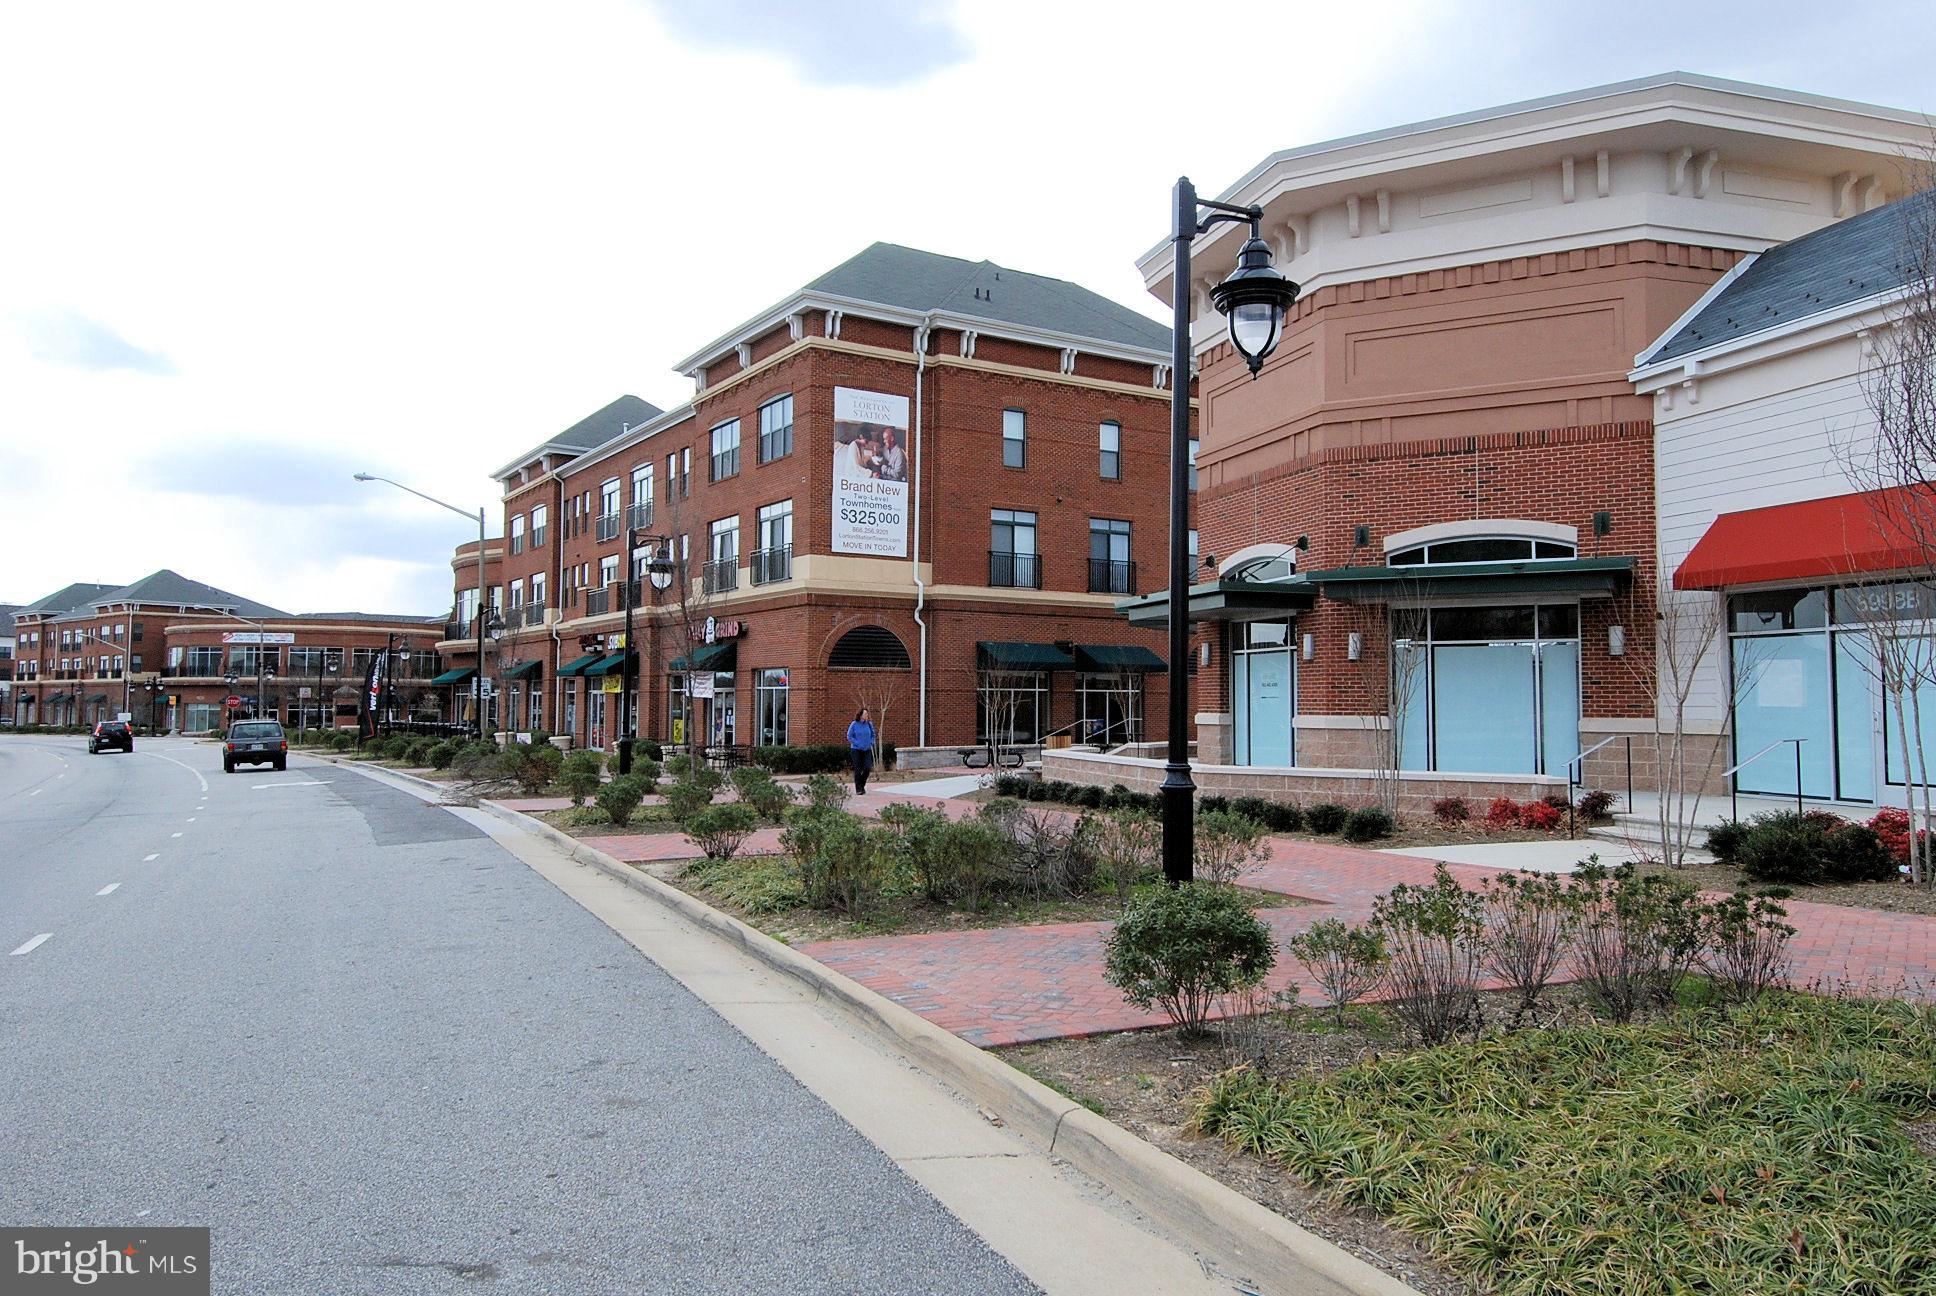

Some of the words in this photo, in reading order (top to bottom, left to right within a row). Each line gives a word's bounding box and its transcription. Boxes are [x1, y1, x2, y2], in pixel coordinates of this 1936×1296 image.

[853, 400, 890, 413] LORTON
[853, 409, 890, 421] STATION
[840, 479, 873, 493] Brand
[876, 482, 901, 496] New
[840, 497, 893, 511] Townhomes
[853, 493, 889, 502] Two-Level
[840, 508, 900, 527] $325,000
[842, 541, 863, 550] MOVE
[874, 544, 897, 552] TODAY
